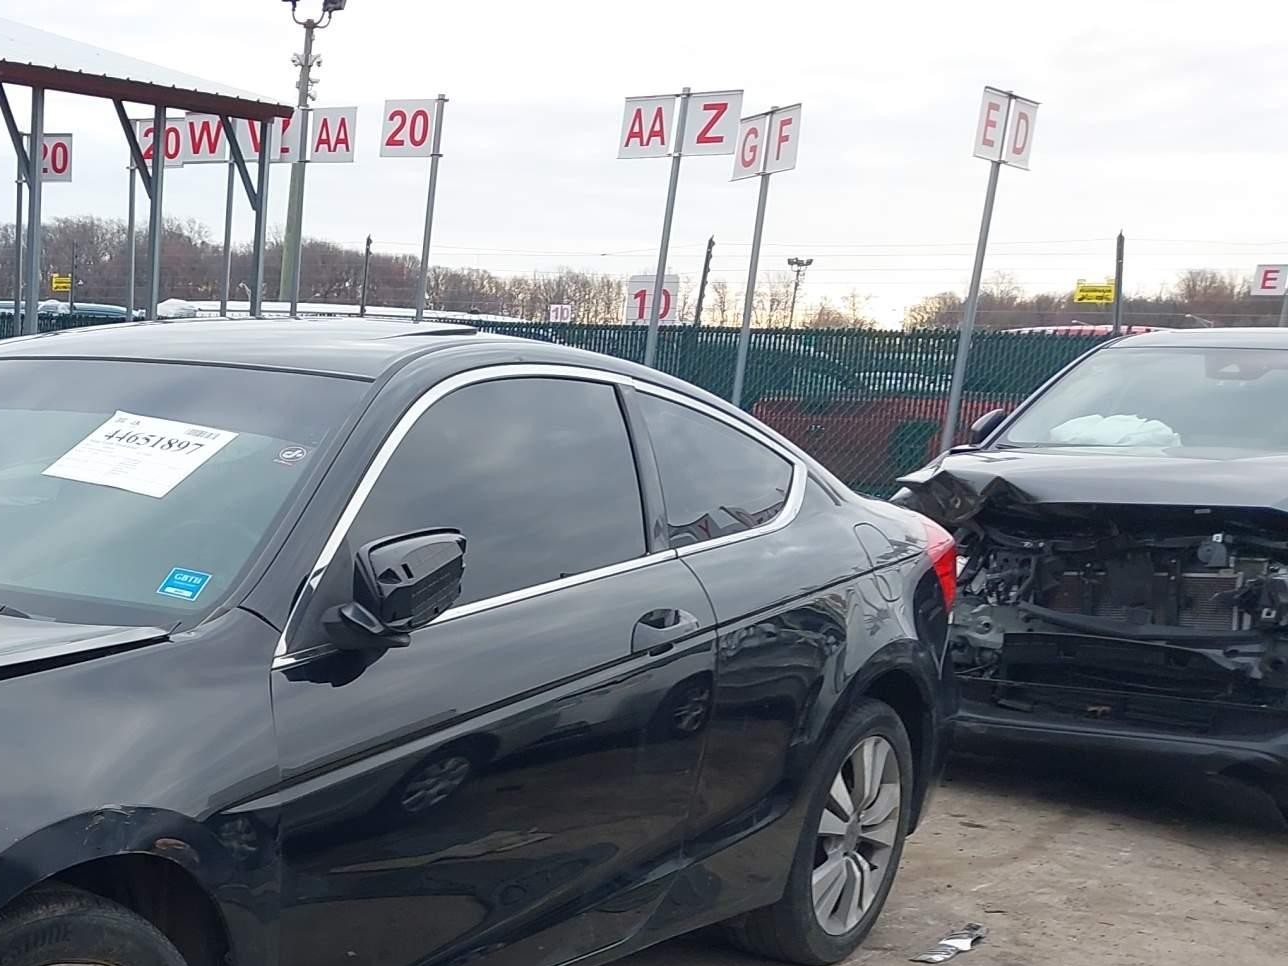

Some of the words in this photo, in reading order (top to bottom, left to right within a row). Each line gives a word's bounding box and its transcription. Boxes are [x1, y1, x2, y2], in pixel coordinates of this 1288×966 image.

[188, 120, 223, 155] W
[315, 117, 350, 153] AA
[385, 109, 429, 148] 20
[624, 107, 665, 147] AA
[696, 103, 728, 144] Z
[741, 127, 759, 168] G
[775, 118, 793, 161] F
[982, 102, 1000, 148] E
[1012, 111, 1029, 155] D
[1260, 269, 1280, 290] E
[104, 429, 205, 455] 44651897
